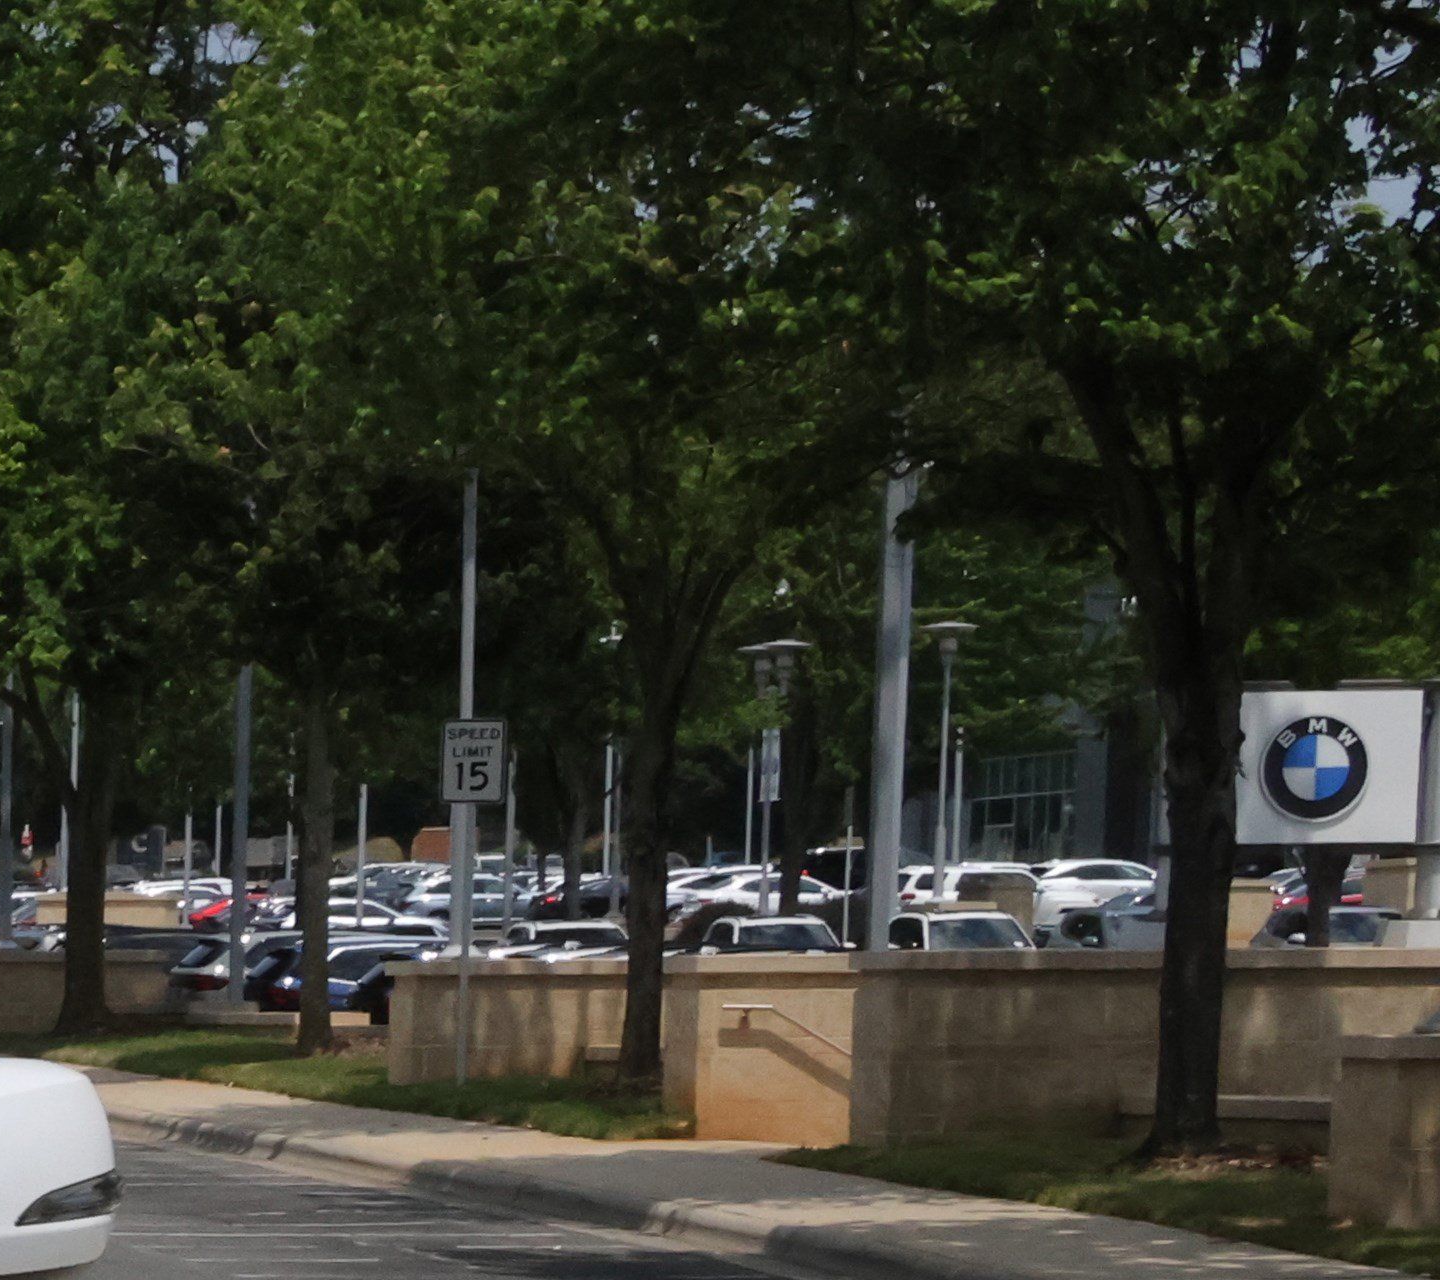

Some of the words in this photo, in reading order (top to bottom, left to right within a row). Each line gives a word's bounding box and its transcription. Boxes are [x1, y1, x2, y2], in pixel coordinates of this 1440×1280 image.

[447, 728, 501, 740] SPEED
[1277, 717, 1357, 749] BMW
[452, 746, 493, 758] LIMIT
[456, 761, 489, 791] 15
